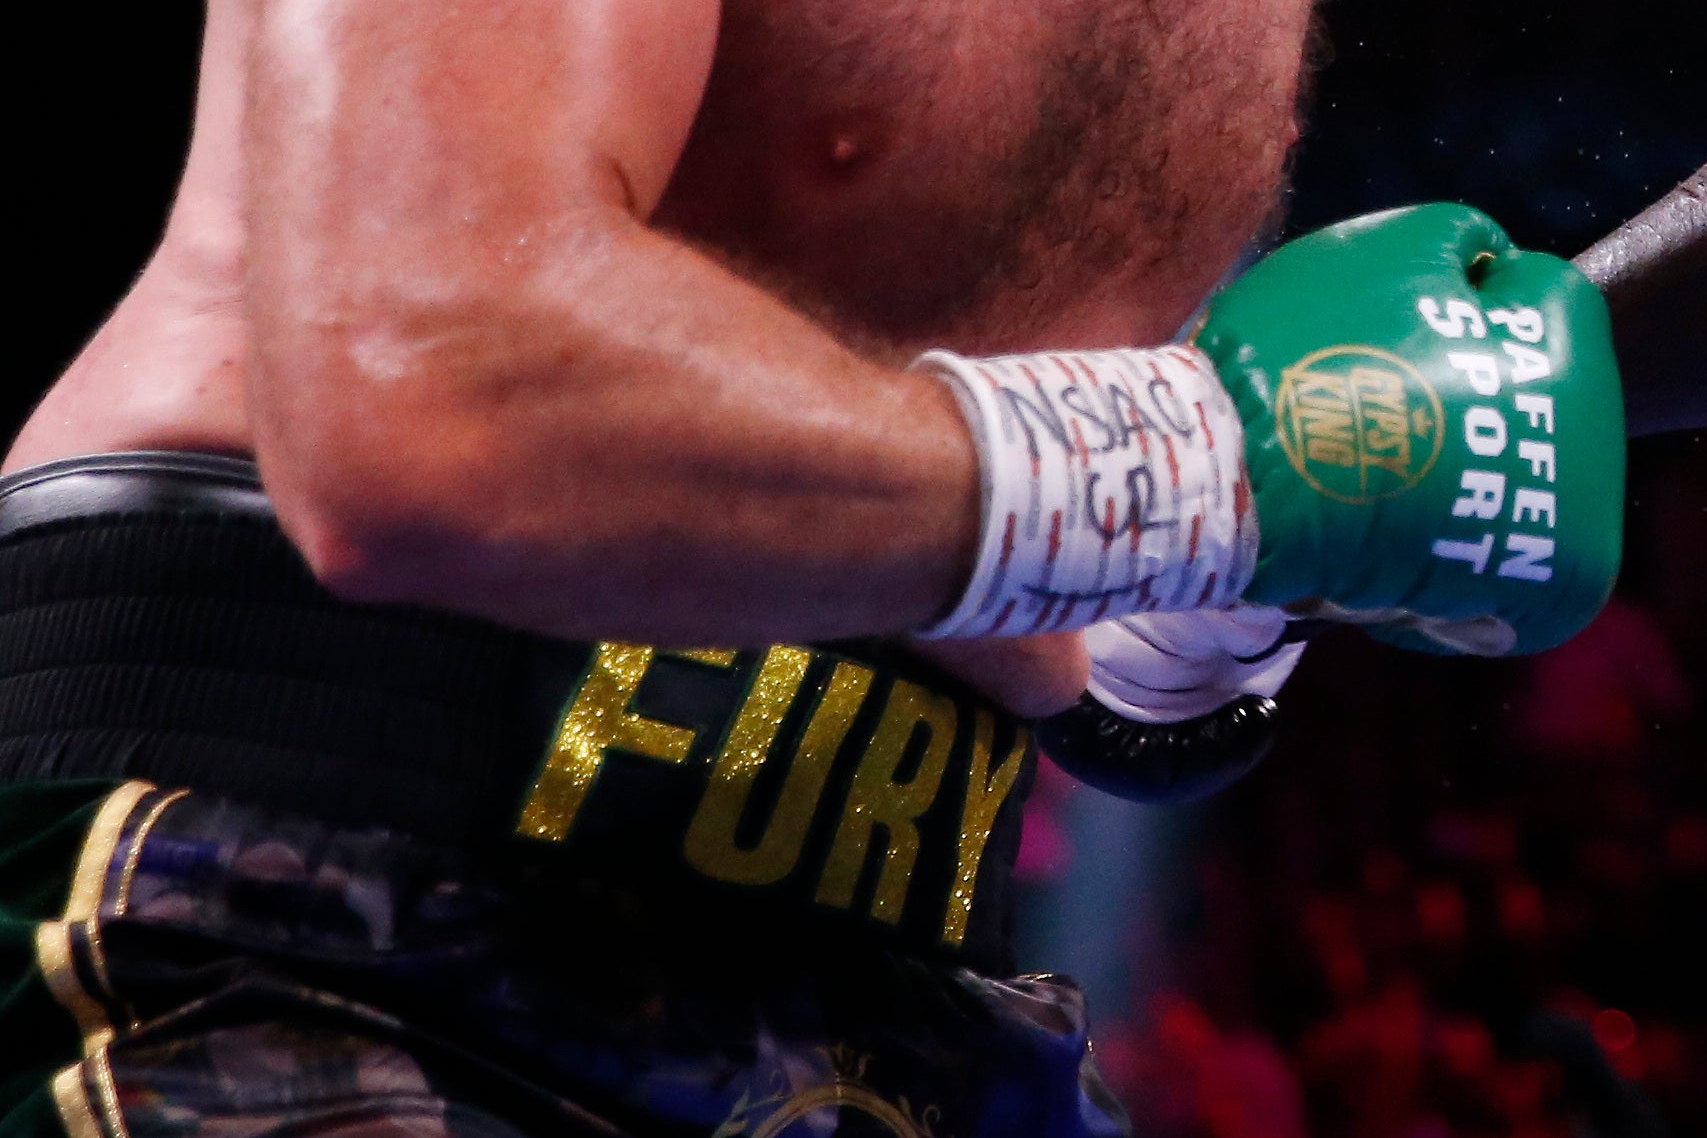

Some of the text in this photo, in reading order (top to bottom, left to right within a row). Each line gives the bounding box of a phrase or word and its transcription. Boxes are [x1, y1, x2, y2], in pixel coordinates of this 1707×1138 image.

[1290, 366, 1357, 467] KING
[1350, 366, 1411, 480] GYPSY
[1418, 297, 1508, 574] SPORT
[1488, 307, 1556, 581] PAFFEN
[515, 640, 1035, 944] FURY
